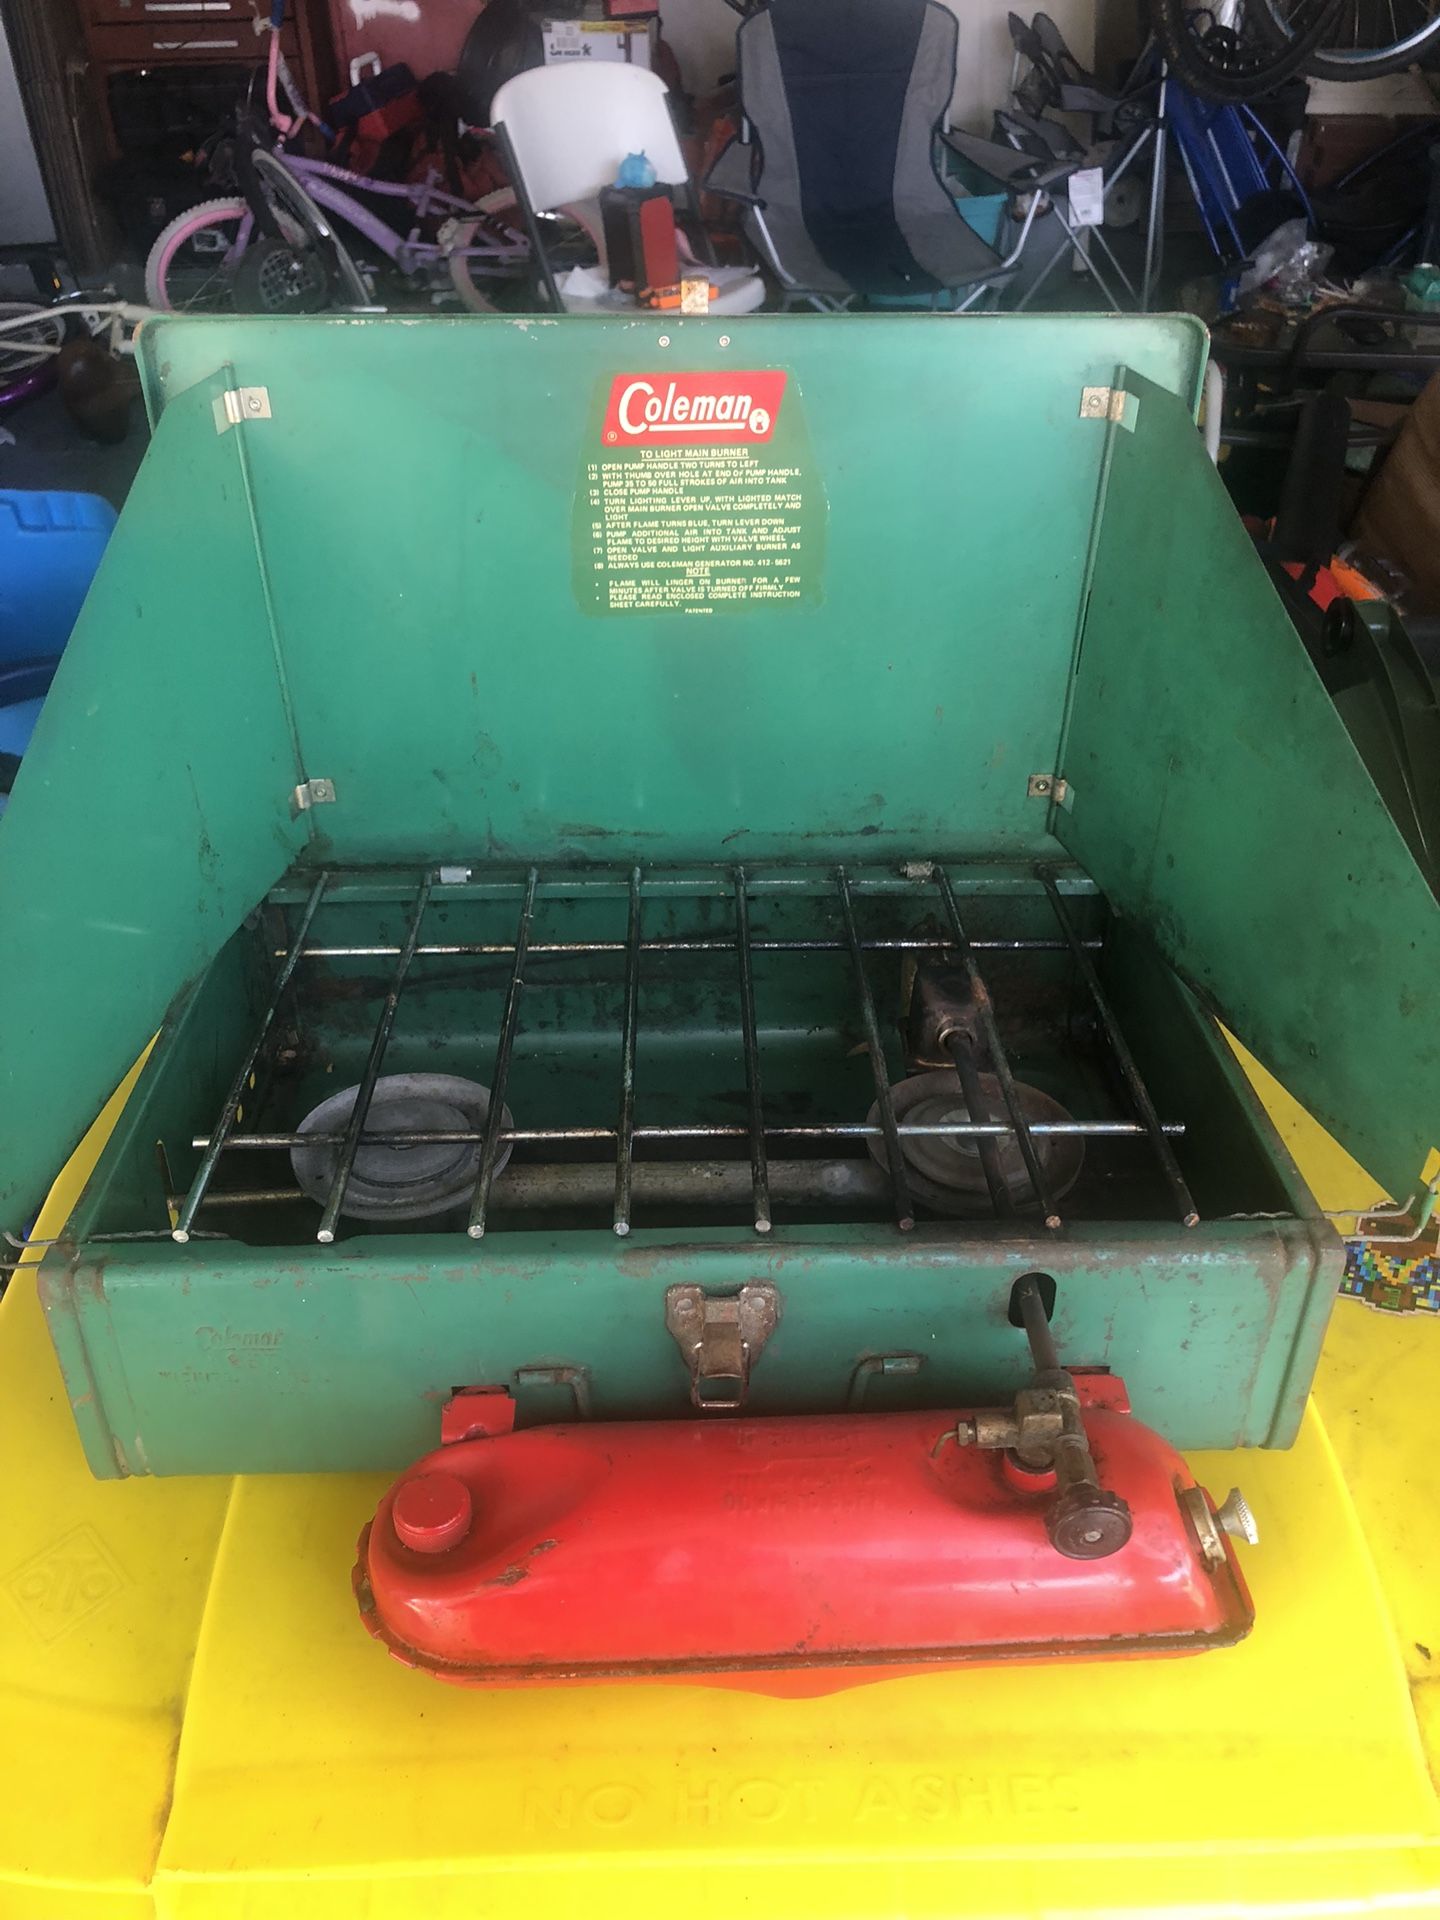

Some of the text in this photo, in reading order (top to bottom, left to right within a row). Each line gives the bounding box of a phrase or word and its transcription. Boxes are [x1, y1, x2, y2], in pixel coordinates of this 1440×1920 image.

[619, 382, 752, 434] Coleman
[655, 450, 682, 458] LIGHT
[685, 449, 709, 457] MAIN
[711, 448, 748, 456] BURNER
[647, 462, 678, 470] HANDLE
[625, 472, 652, 480] THUMB
[680, 478, 715, 486] STROKES
[682, 536, 709, 544] HEIGHT
[608, 561, 639, 569] ALWAYS
[686, 567, 710, 575] NOTE
[708, 591, 746, 599] COMPLETE
[635, 600, 681, 608] CAREFULLY.
[521, 1772, 1081, 1833] NO HOT ASHES
